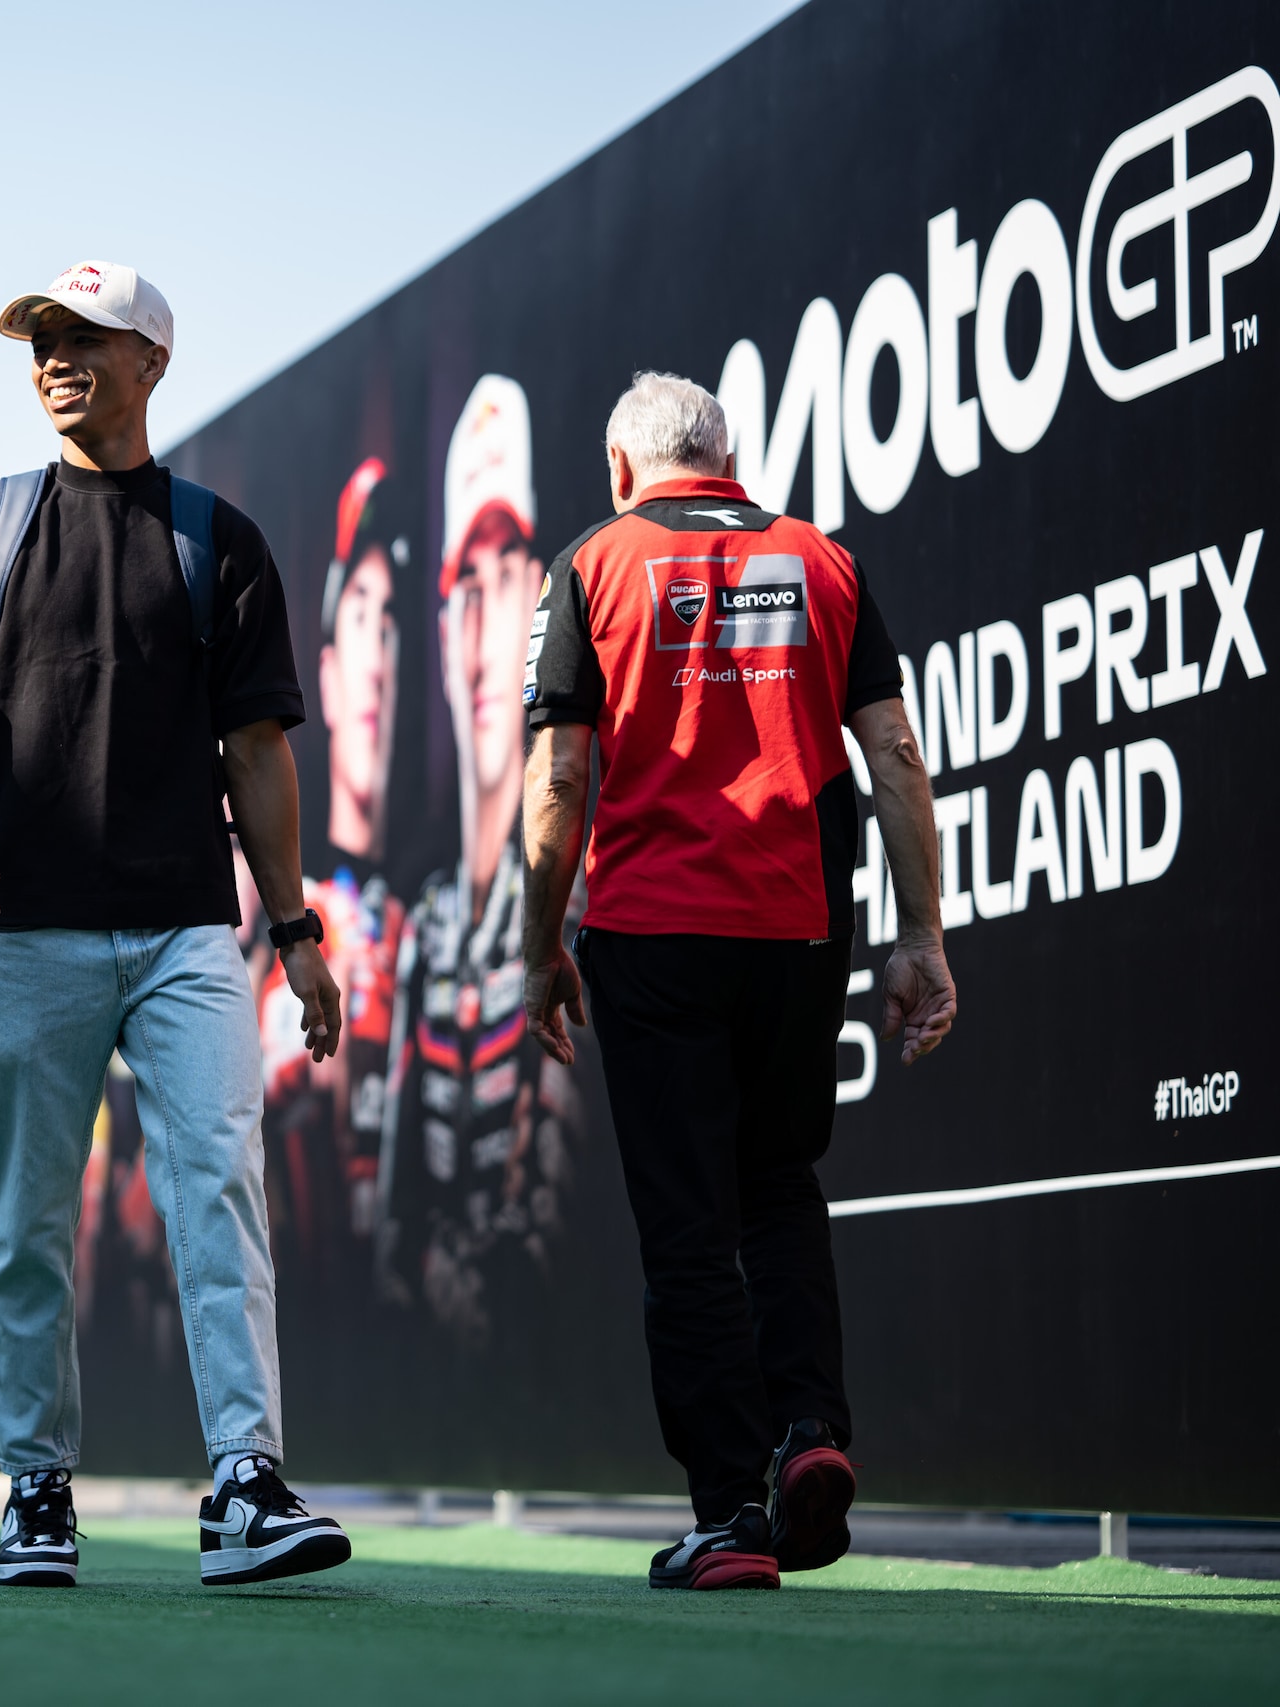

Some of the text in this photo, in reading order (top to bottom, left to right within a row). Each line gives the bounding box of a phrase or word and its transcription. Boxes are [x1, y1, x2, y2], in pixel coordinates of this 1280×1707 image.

[69, 280, 102, 296] Bull
[670, 584, 703, 594] DUCATI
[722, 591, 796, 608] Lenovo
[1042, 528, 1267, 741] PRIX
[697, 667, 796, 684] Audi Sport
[1154, 1070, 1240, 1121] #ThaiGP
